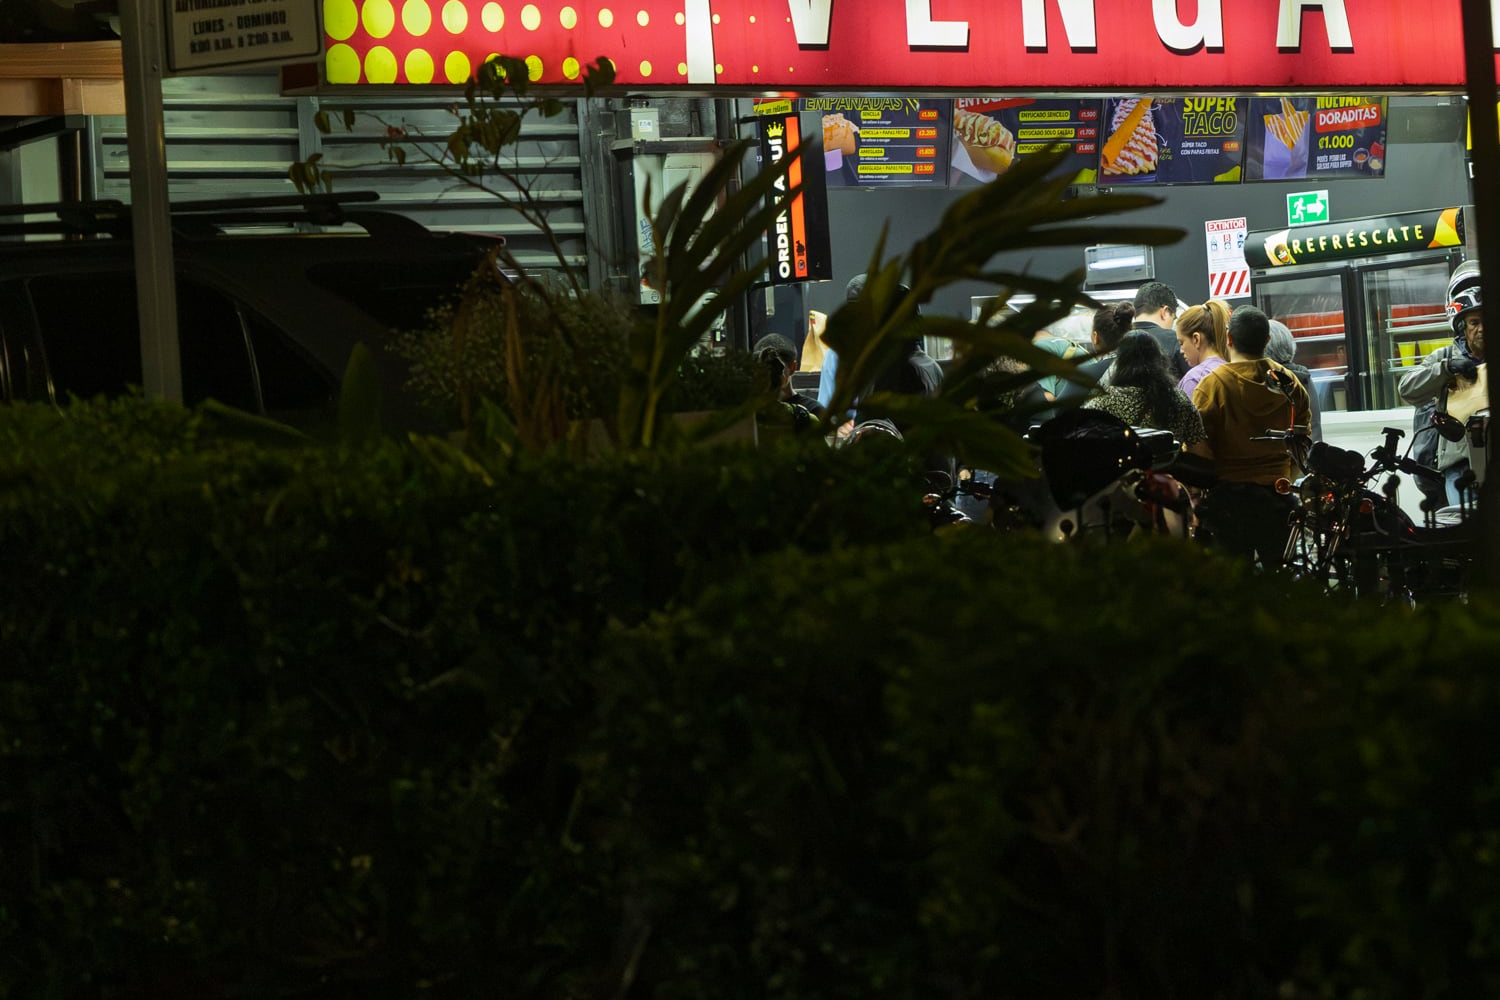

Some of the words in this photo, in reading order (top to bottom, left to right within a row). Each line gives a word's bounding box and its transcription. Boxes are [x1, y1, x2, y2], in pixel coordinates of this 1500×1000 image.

[193, 19, 225, 36] LUNES
[237, 10, 287, 30] DOMINGO
[805, 98, 904, 111] EMPANADAS
[1183, 97, 1236, 112] SUPER
[1182, 111, 1238, 135] TACO
[1319, 107, 1377, 126] DORADITAS
[768, 138, 786, 192] AUÍ
[1207, 220, 1245, 231] EXTINTOR
[1292, 224, 1425, 254] REFRÉSCATE
